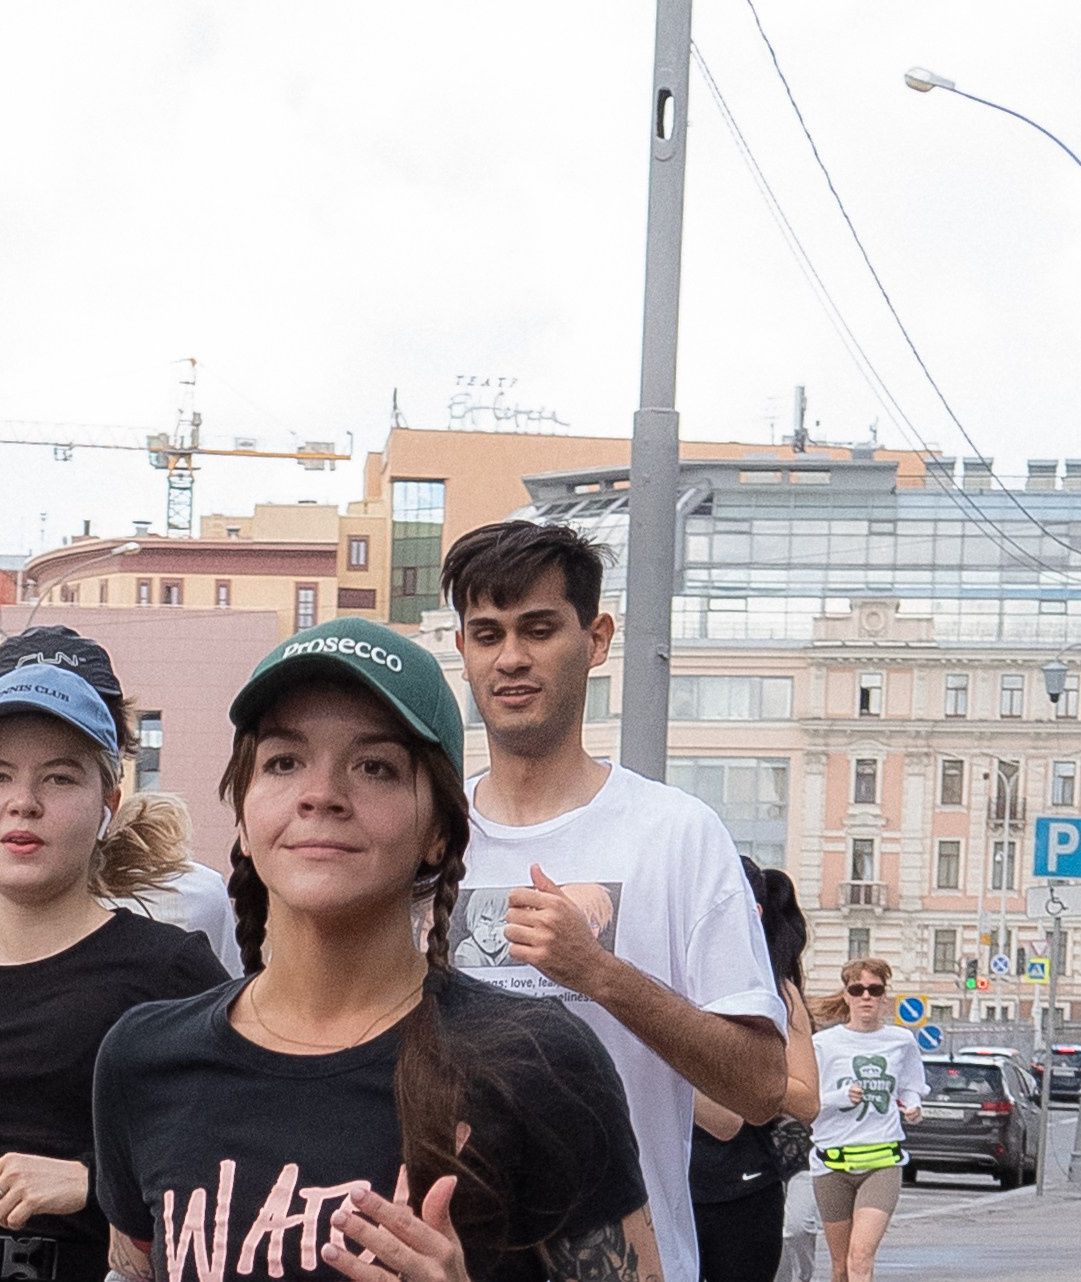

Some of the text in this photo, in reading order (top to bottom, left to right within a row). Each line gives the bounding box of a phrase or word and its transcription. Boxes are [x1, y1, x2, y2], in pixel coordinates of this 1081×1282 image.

[34, 685, 70, 703] CLUB
[1047, 822, 1080, 873] P
[510, 977, 536, 989] love,
